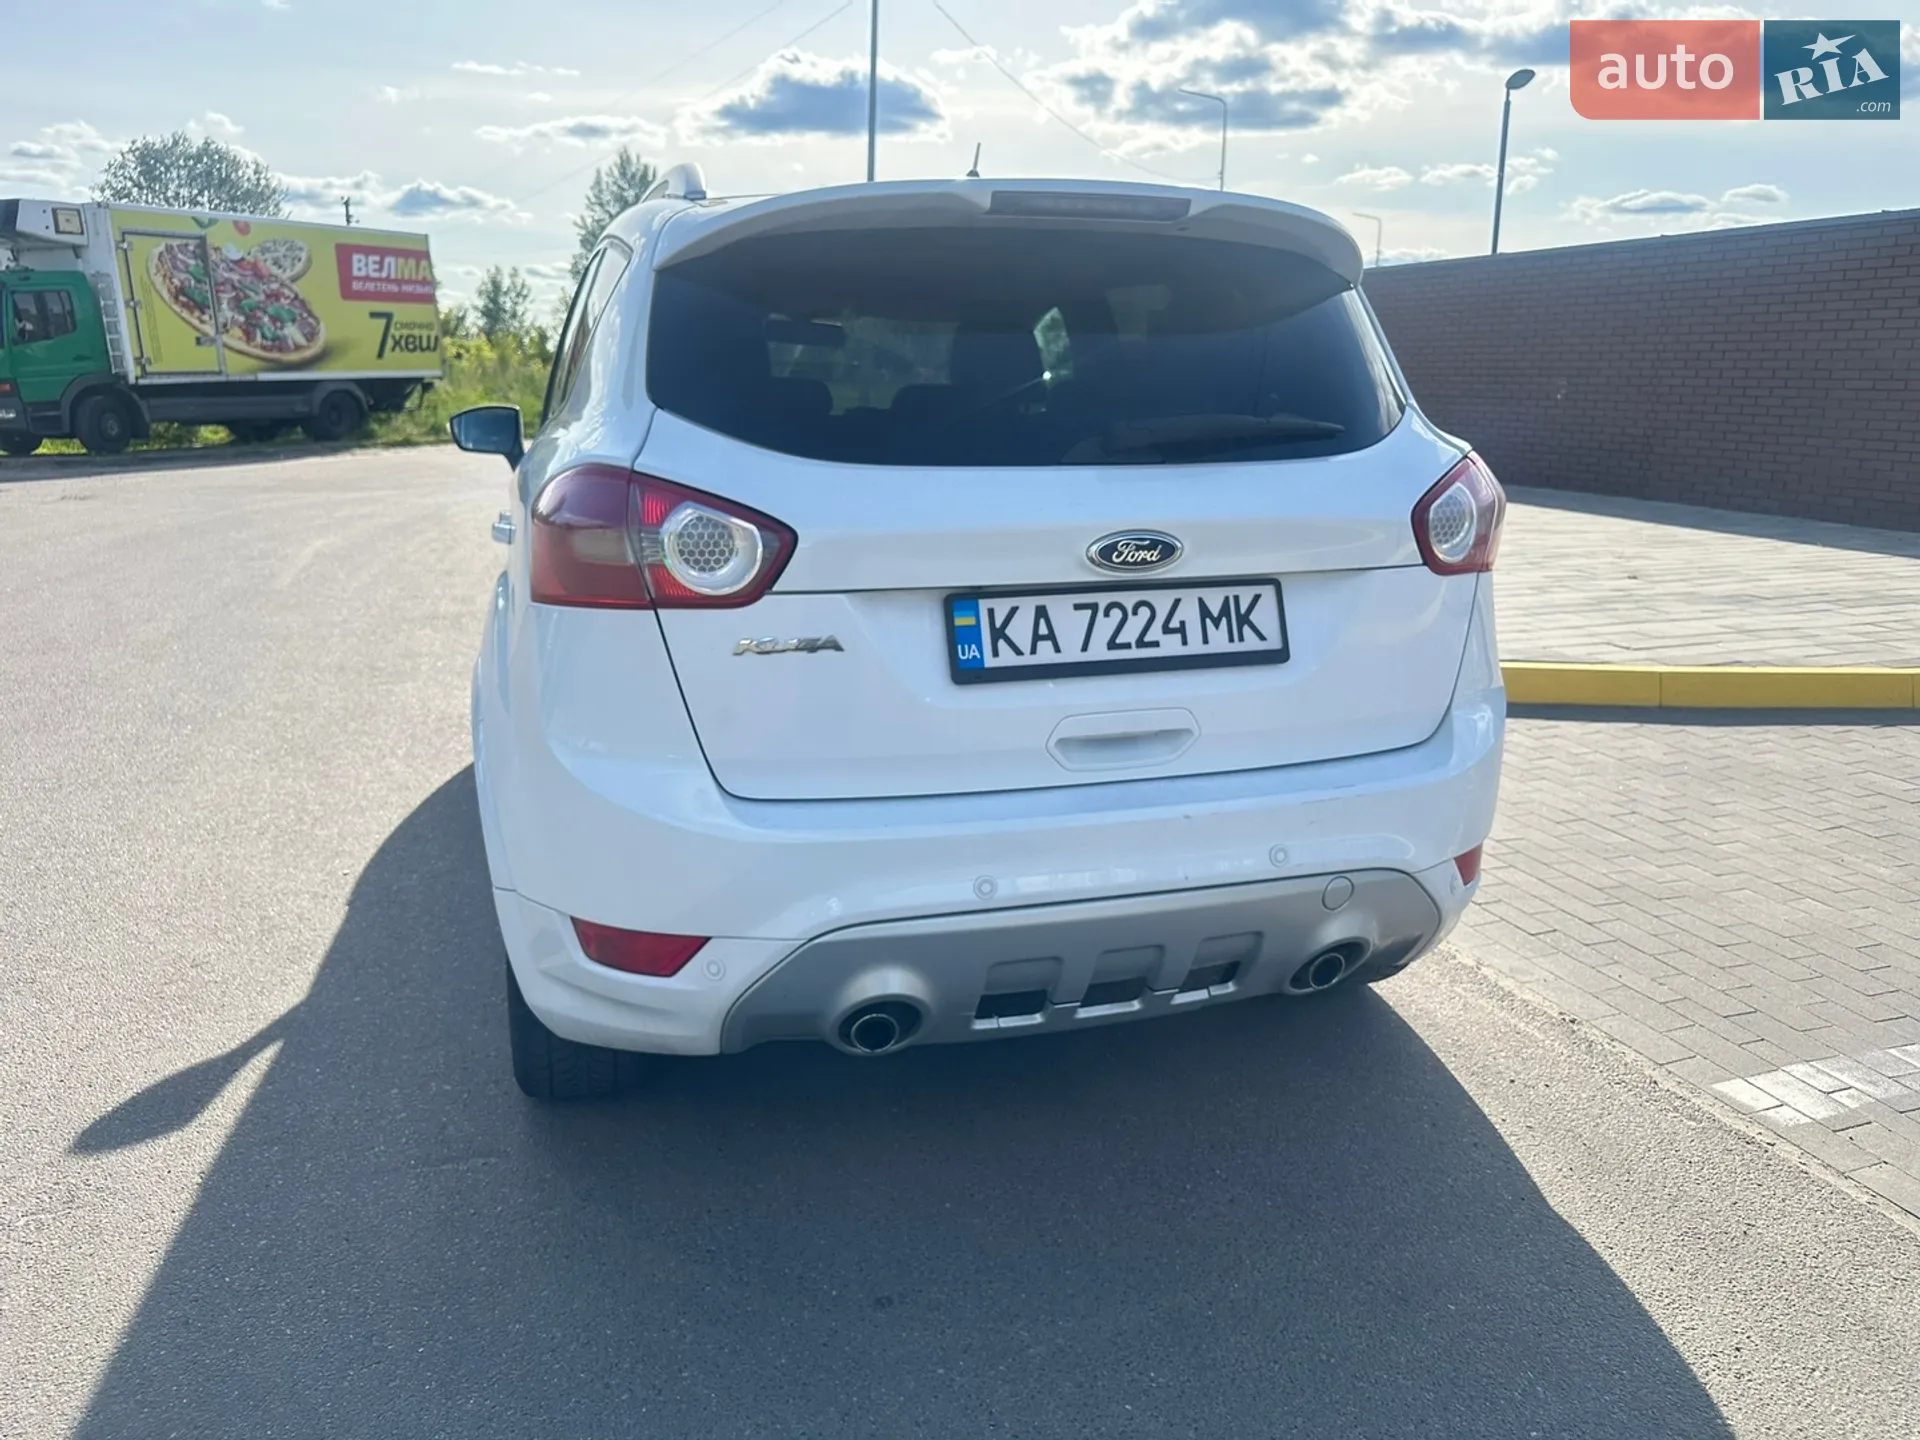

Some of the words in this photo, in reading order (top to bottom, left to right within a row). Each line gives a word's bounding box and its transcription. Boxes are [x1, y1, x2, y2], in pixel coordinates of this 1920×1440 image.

[352, 253, 433, 280] ВЕЛМА
[369, 311, 393, 359] 7
[1112, 540, 1162, 563] Ford
[987, 604, 1062, 658] KA
[1073, 599, 1188, 653] 7224
[1198, 593, 1268, 645] MK
[958, 644, 981, 660] UA
